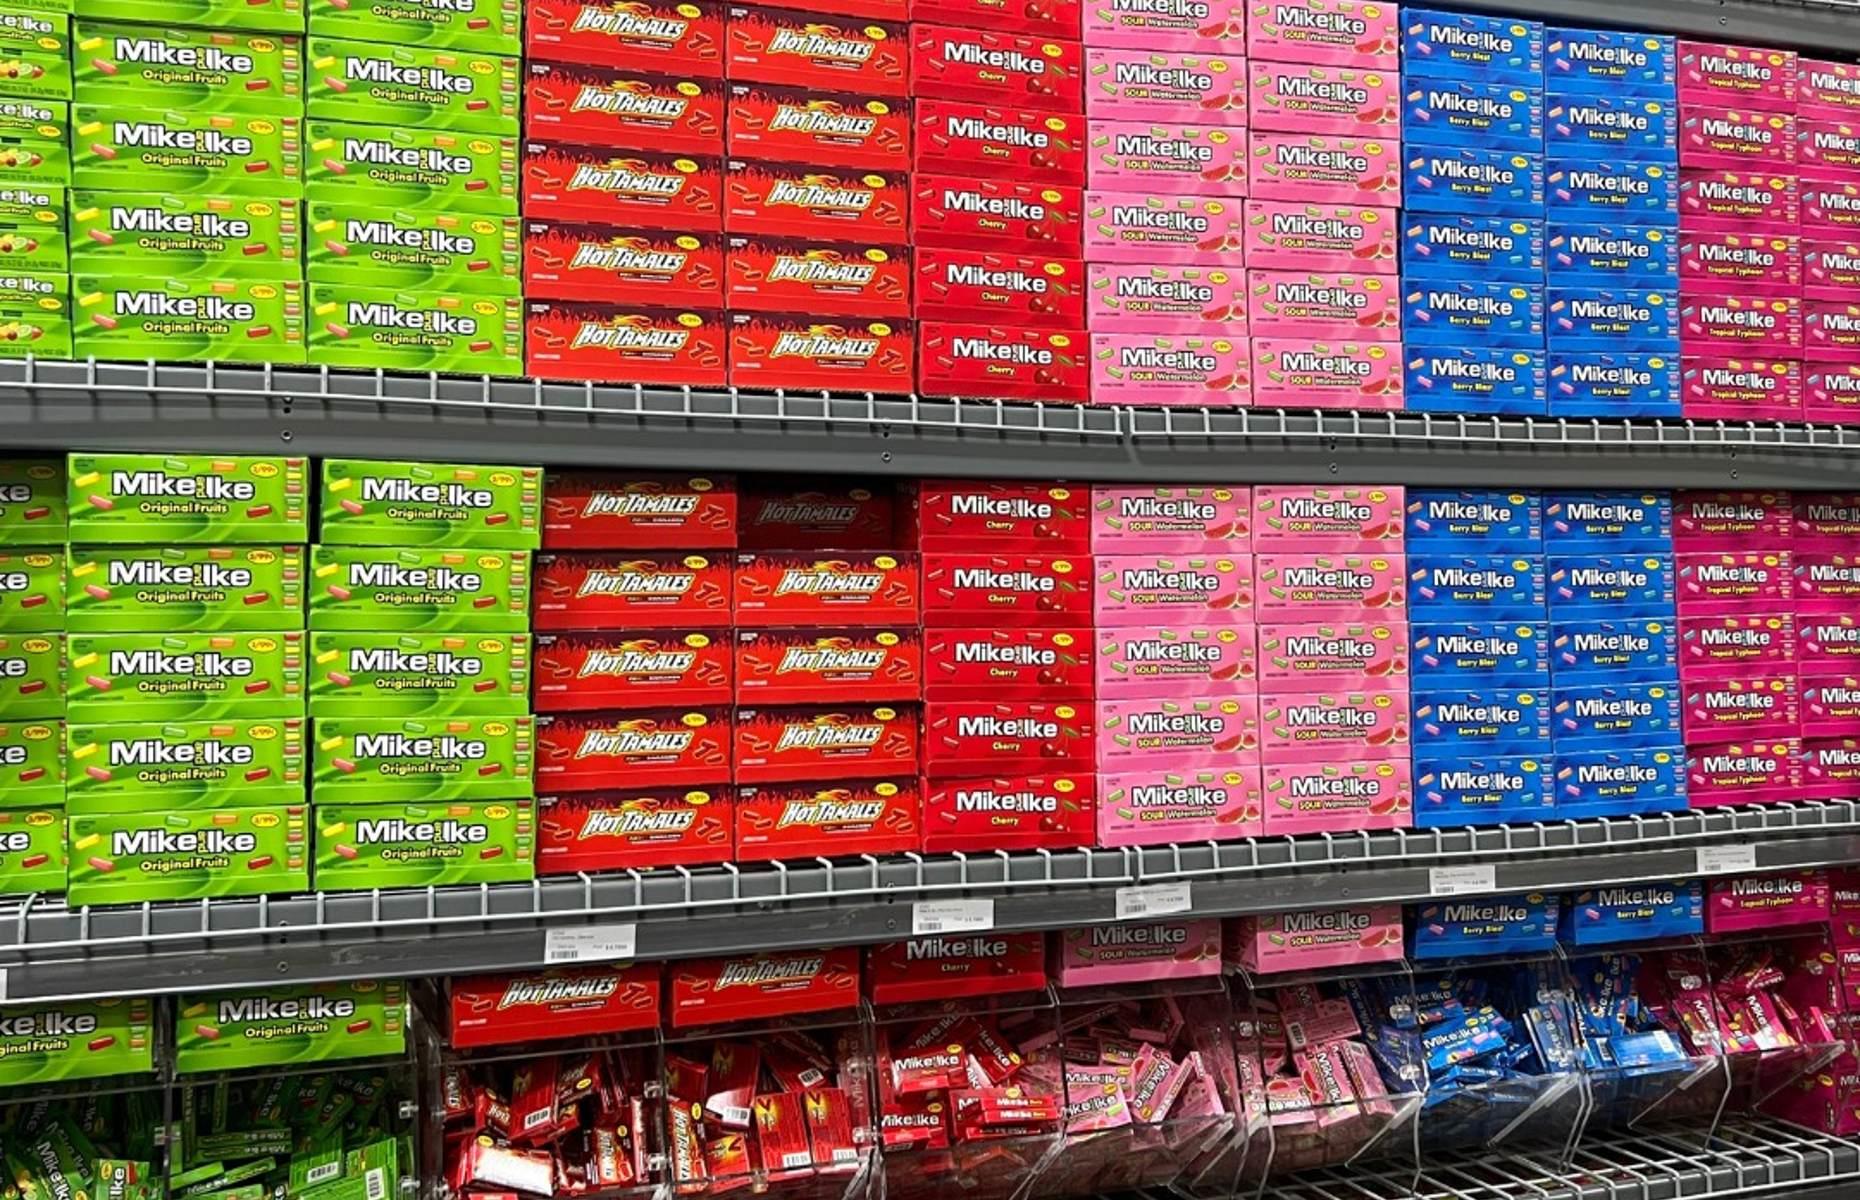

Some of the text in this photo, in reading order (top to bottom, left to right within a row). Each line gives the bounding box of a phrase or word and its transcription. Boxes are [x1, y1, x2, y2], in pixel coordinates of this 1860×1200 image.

[372, 6, 420, 19] Original
[805, 35, 872, 57] TAMALES
[1570, 42, 1646, 66] Mike Ike
[346, 58, 472, 92] Mike Ike
[1811, 72, 1850, 91] Mike
[611, 91, 685, 116] TAMALES
[1429, 92, 1512, 118] Mike Ike
[115, 123, 195, 151] Mike
[206, 132, 252, 155] Ike
[948, 117, 1047, 147] Mike Ike
[1703, 120, 1772, 144] Mike Ike
[142, 153, 227, 169] Original Fruits
[983, 146, 1010, 158] Cherry
[1278, 146, 1366, 171] Mike Ike
[1285, 169, 1307, 180] SOUR
[1113, 208, 1208, 232] Mike Ike
[1121, 231, 1145, 242] SOUR
[1571, 236, 1649, 258] Mike Ike
[806, 260, 873, 282] TAMALES
[1118, 278, 1212, 302] Mike Ike
[116, 291, 254, 321] Mike Ike
[1429, 292, 1512, 316] Mike Ike
[349, 302, 475, 334] Mike Ike
[1702, 307, 1774, 329] Mike Ike
[372, 332, 452, 347] Original Fruits
[612, 324, 686, 349] TAMALES
[953, 337, 1051, 364] Mike Ike
[1282, 352, 1370, 376] Mike Ike
[112, 473, 255, 500] Mike Ike
[622, 494, 696, 514] TAMALES
[951, 496, 1052, 519] Mike Ike
[1430, 502, 1510, 522] Mike Ike
[350, 565, 481, 590] Mike Ike
[813, 573, 882, 592] TAMALES
[1124, 571, 1218, 592] Mike Ike
[1285, 569, 1373, 590] Mike Ike
[1571, 569, 1646, 587] Mike Ike
[1699, 566, 1767, 582] Mike Ike
[376, 592, 456, 606] Original Fruits
[1293, 591, 1315, 601] SOUR
[1818, 626, 1856, 642] Mike
[955, 643, 1056, 665] Mike Ike
[1437, 636, 1518, 655] Mike Ike
[110, 652, 193, 676] Mike
[204, 653, 253, 676] Ike
[618, 652, 692, 672] TAMALES
[990, 667, 1018, 678] Cherry
[138, 678, 225, 694] Original Fruits
[1706, 692, 1774, 708] Mike Ike
[1288, 707, 1376, 728] Mike Ike
[354, 735, 485, 758] Mike Ike
[1579, 765, 1656, 783] Mike Ike
[1132, 787, 1227, 808] Mike Ike
[815, 802, 884, 821] TAMALES
[1141, 811, 1164, 821] SOUR
[1600, 888, 1674, 907] Mike Ike
[1732, 880, 1802, 896] Mike Ike
[1284, 912, 1370, 932] Mike Ike
[1445, 905, 1527, 922] Mike Ike
[1093, 927, 1186, 945] Mike Ike
[1291, 937, 1313, 946] SOUR
[907, 939, 1007, 960] Mike Ike
[219, 998, 353, 1022] Mike Ike
[46, 1014, 95, 1034] Ike
[245, 1023, 328, 1038] Original Fruits
[33, 1040, 68, 1053] Fruits
[896, 1055, 959, 1071] Mike Ike
